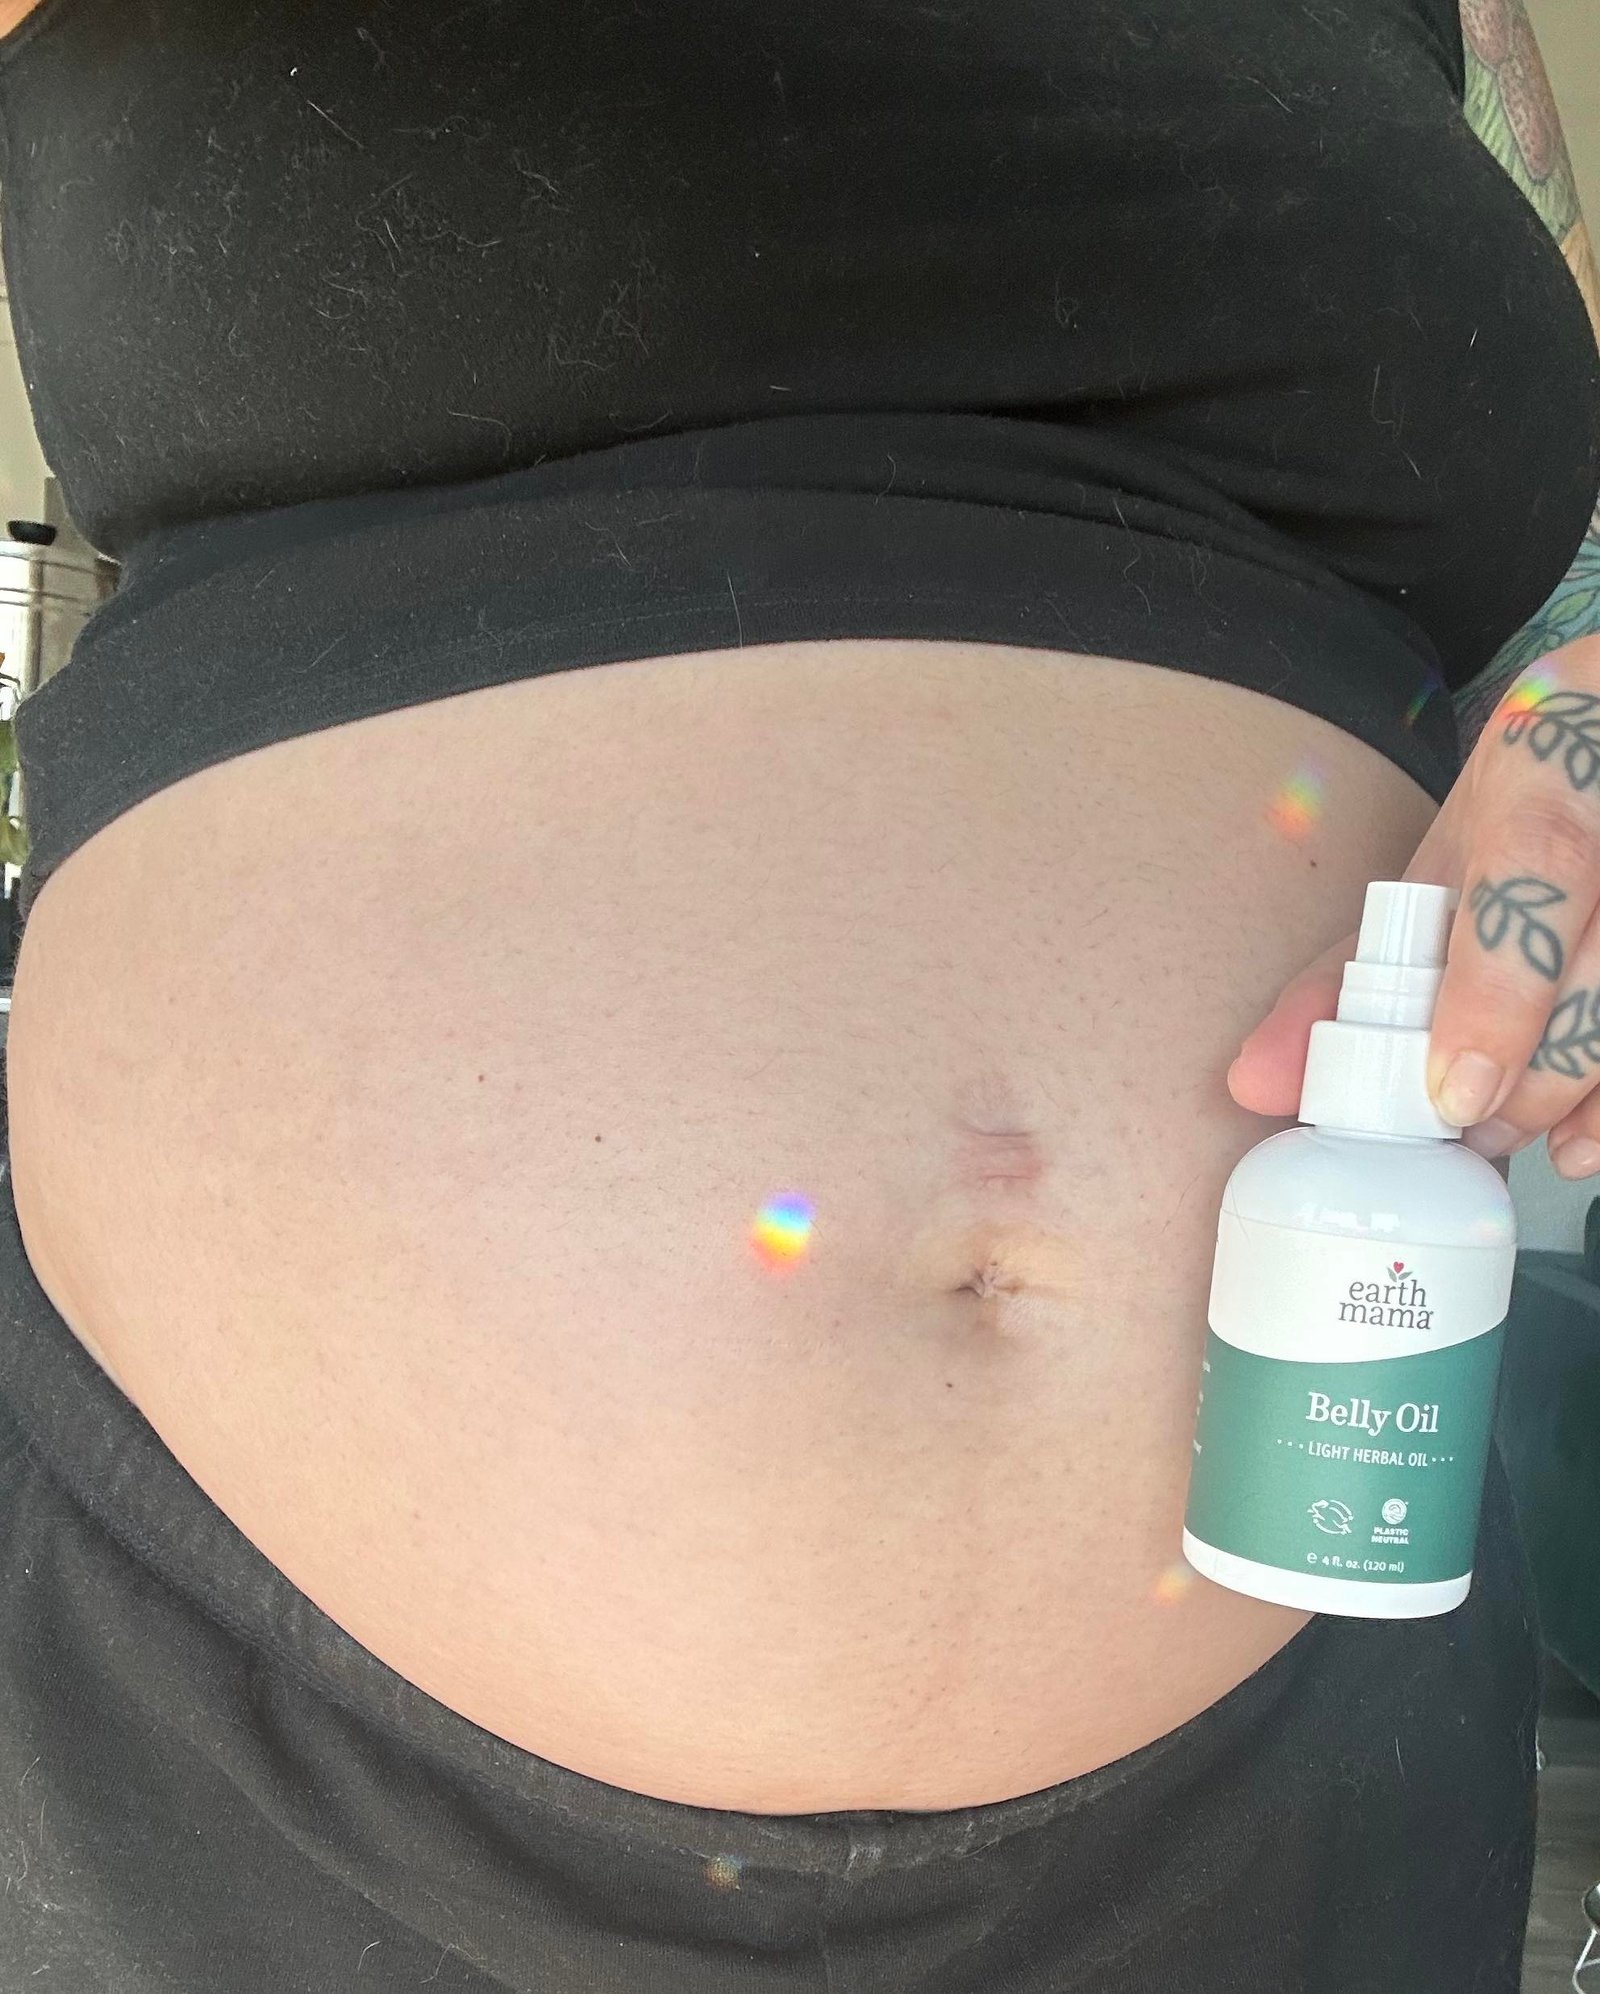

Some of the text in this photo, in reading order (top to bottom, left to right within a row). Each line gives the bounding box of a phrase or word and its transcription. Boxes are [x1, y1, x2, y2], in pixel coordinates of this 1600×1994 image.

[1349, 1280, 1427, 1307] earth
[1338, 1301, 1432, 1330] mama
[1306, 1392, 1439, 1436] Belly Oil
[1308, 1441, 1428, 1467] LIGHT HERBAL OIL
[1371, 1535, 1409, 1544] NEUTRAL
[1374, 1527, 1409, 1536] PLASTIC
[1322, 1556, 1329, 1566] 4
[1332, 1555, 1343, 1567] fl.
[1345, 1559, 1360, 1569] oz.
[1363, 1559, 1386, 1572] (120
[1388, 1560, 1404, 1574] ml)
